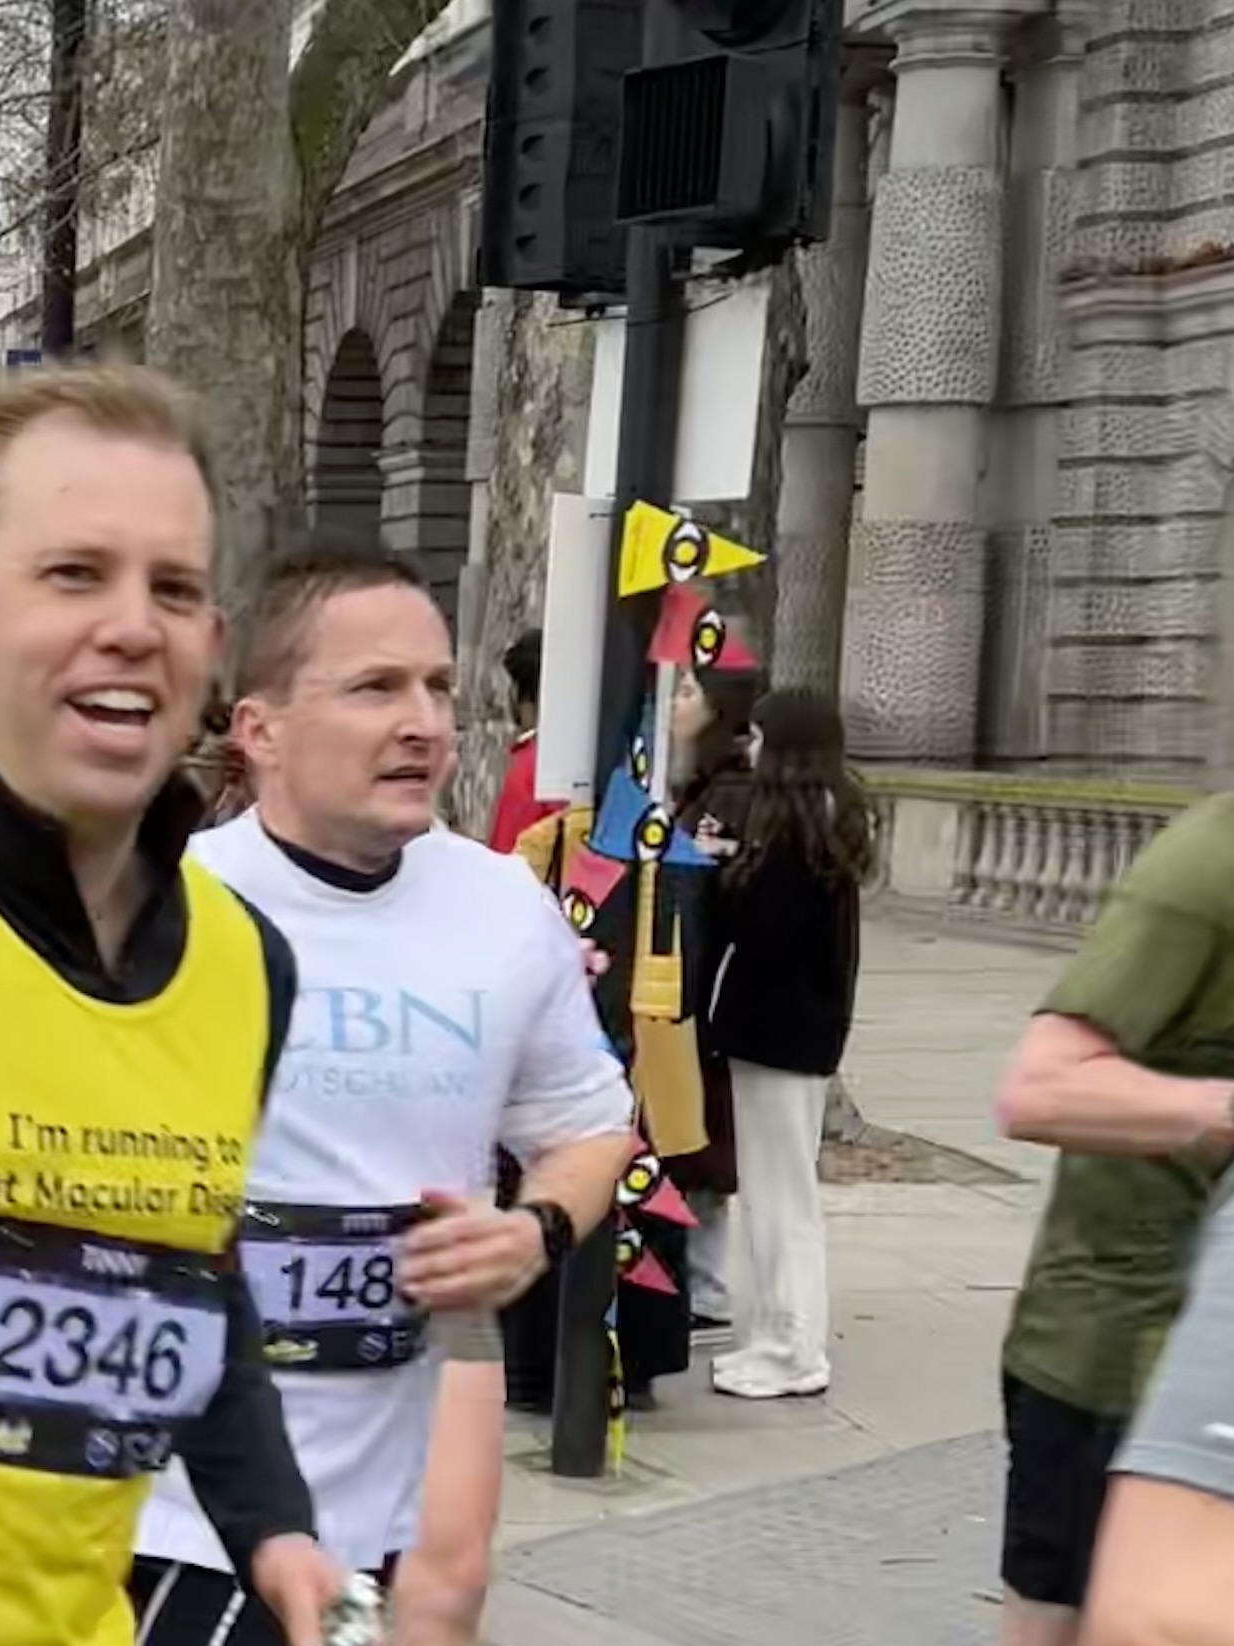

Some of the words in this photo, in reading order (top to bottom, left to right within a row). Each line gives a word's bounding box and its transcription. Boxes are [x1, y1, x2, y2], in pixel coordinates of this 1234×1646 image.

[7, 1112, 70, 1153] I'm
[82, 1122, 210, 1172] running
[33, 1170, 180, 1214] Macular
